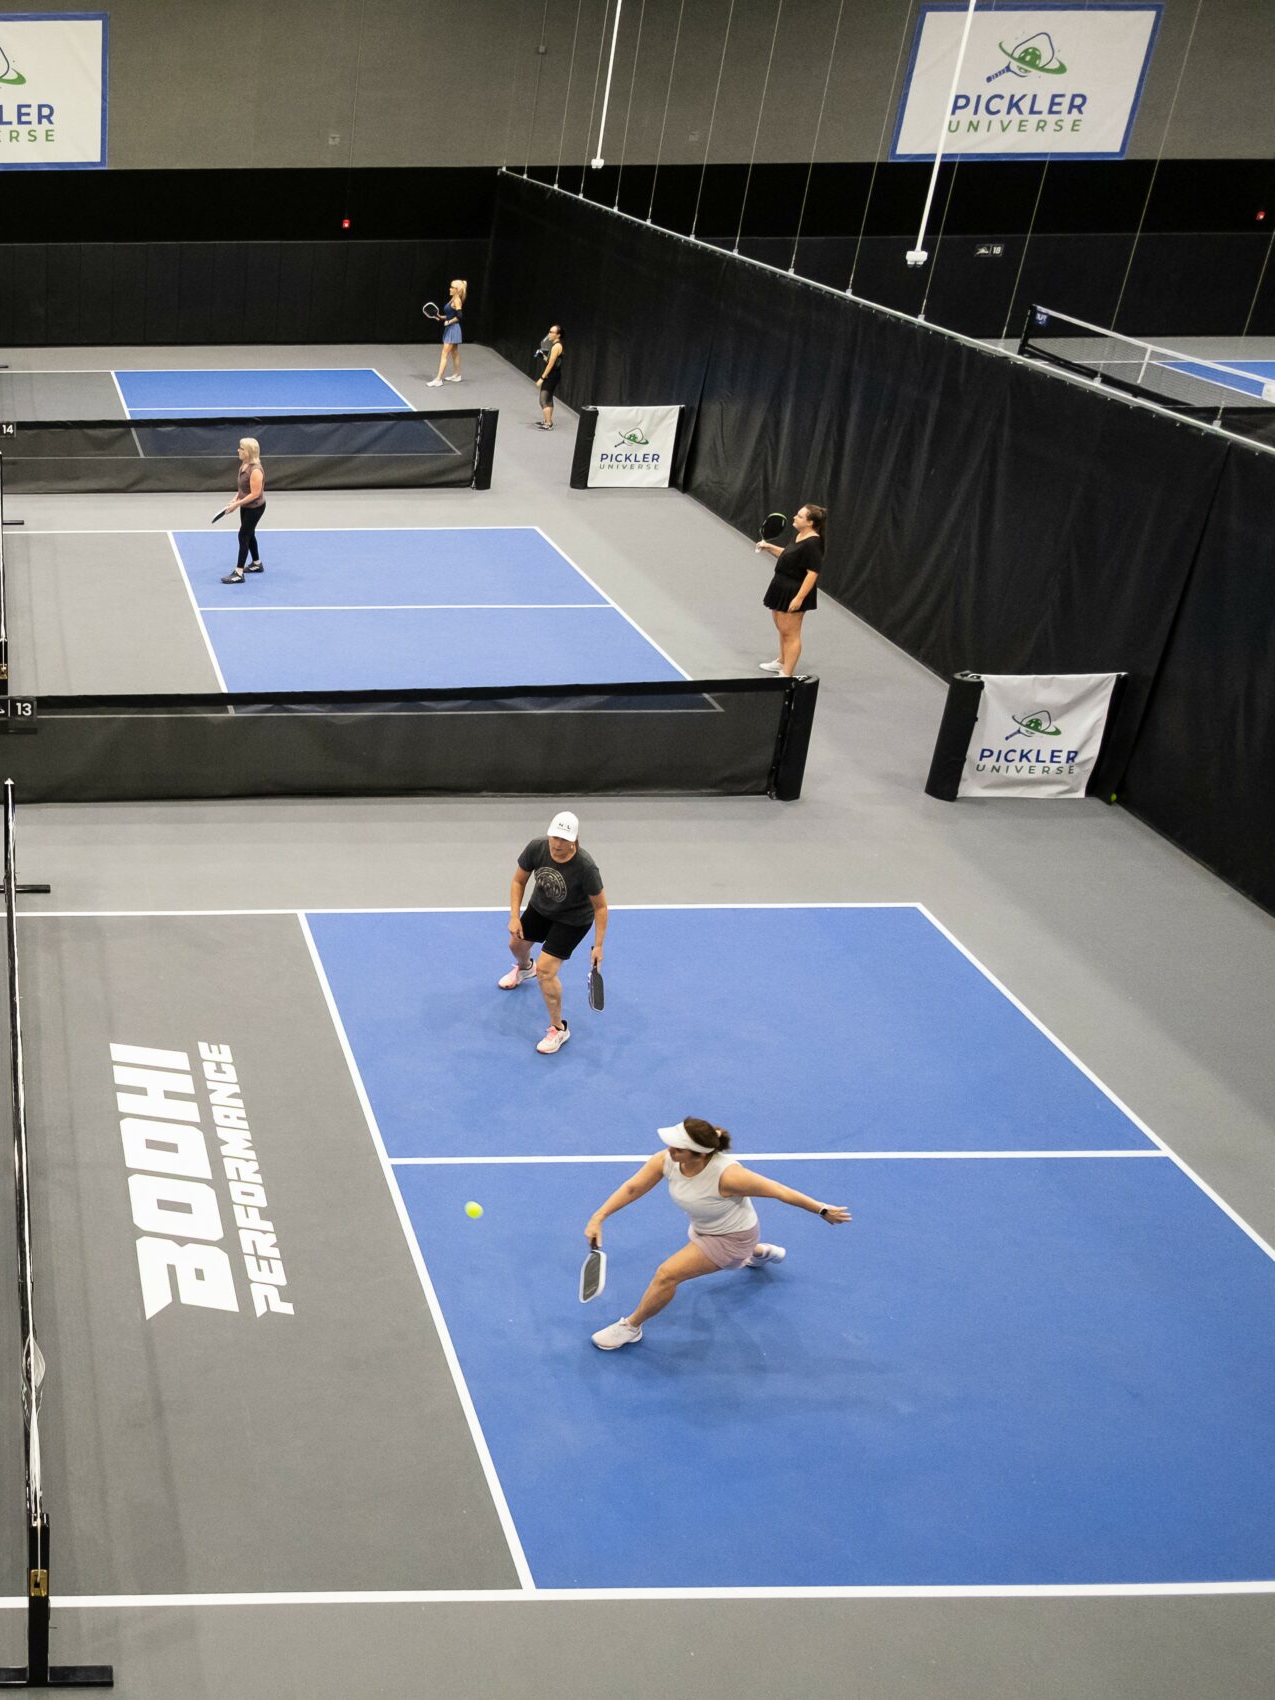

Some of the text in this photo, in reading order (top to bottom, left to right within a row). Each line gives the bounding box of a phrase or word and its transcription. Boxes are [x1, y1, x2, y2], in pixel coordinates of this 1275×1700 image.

[950, 93, 1088, 116] PICKLER
[947, 119, 1082, 133] UNIVERSE
[2, 424, 14, 434] 14
[600, 453, 660, 463] PICKLER
[15, 702, 32, 716] 13
[978, 748, 1078, 764] PICKLER
[976, 764, 1076, 775] UNIVERSE
[109, 1042, 239, 1321] BODHI
[197, 1040, 295, 1319] PERFORMANCE
